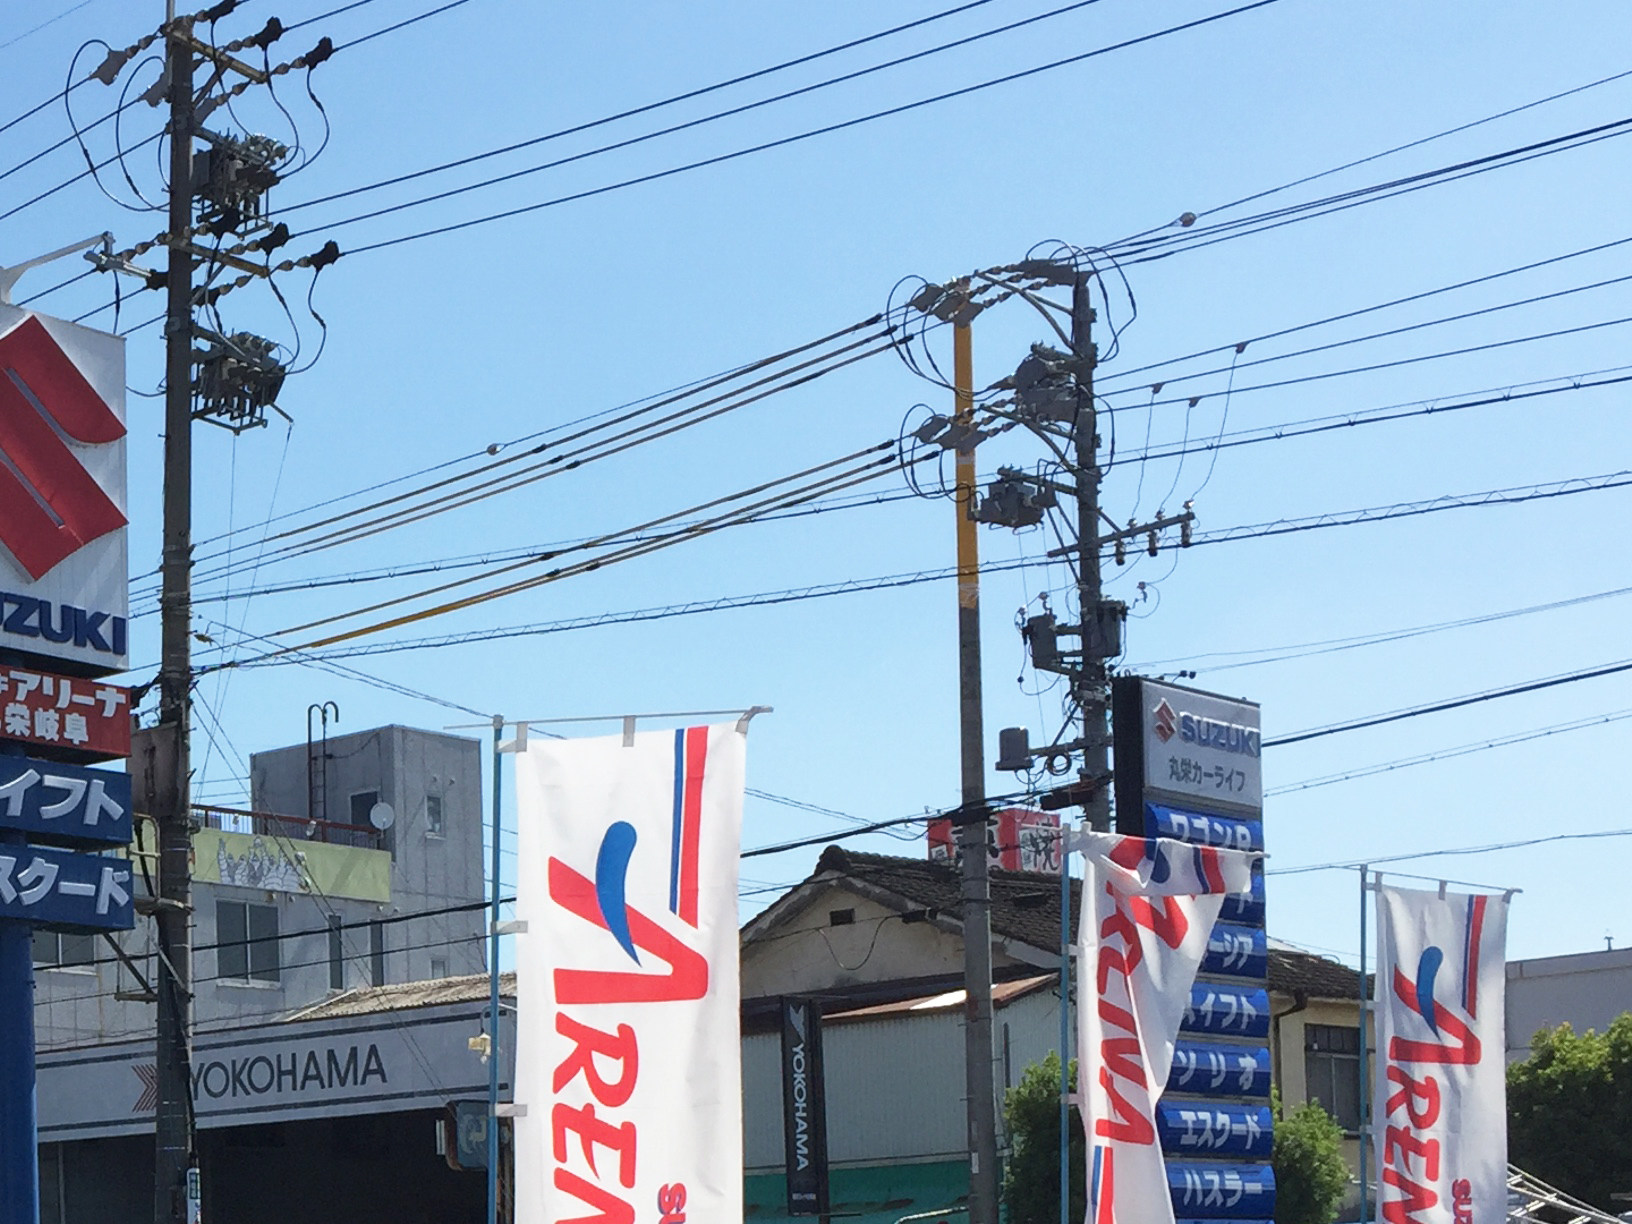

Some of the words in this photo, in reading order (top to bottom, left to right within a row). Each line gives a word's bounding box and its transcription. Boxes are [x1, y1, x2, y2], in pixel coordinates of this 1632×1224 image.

[1179, 711, 1261, 759] SUZUKI
[1169, 755, 1246, 792] 丸栄カーライフ
[1209, 931, 1254, 971] ーシア
[190, 1044, 388, 1101] YOKOHAMA
[1176, 1050, 1258, 1091] ソリオ
[792, 1043, 810, 1172] YOKOHAMA
[1179, 1110, 1261, 1150] エスクード
[1183, 1169, 1263, 1207] ハスラー
